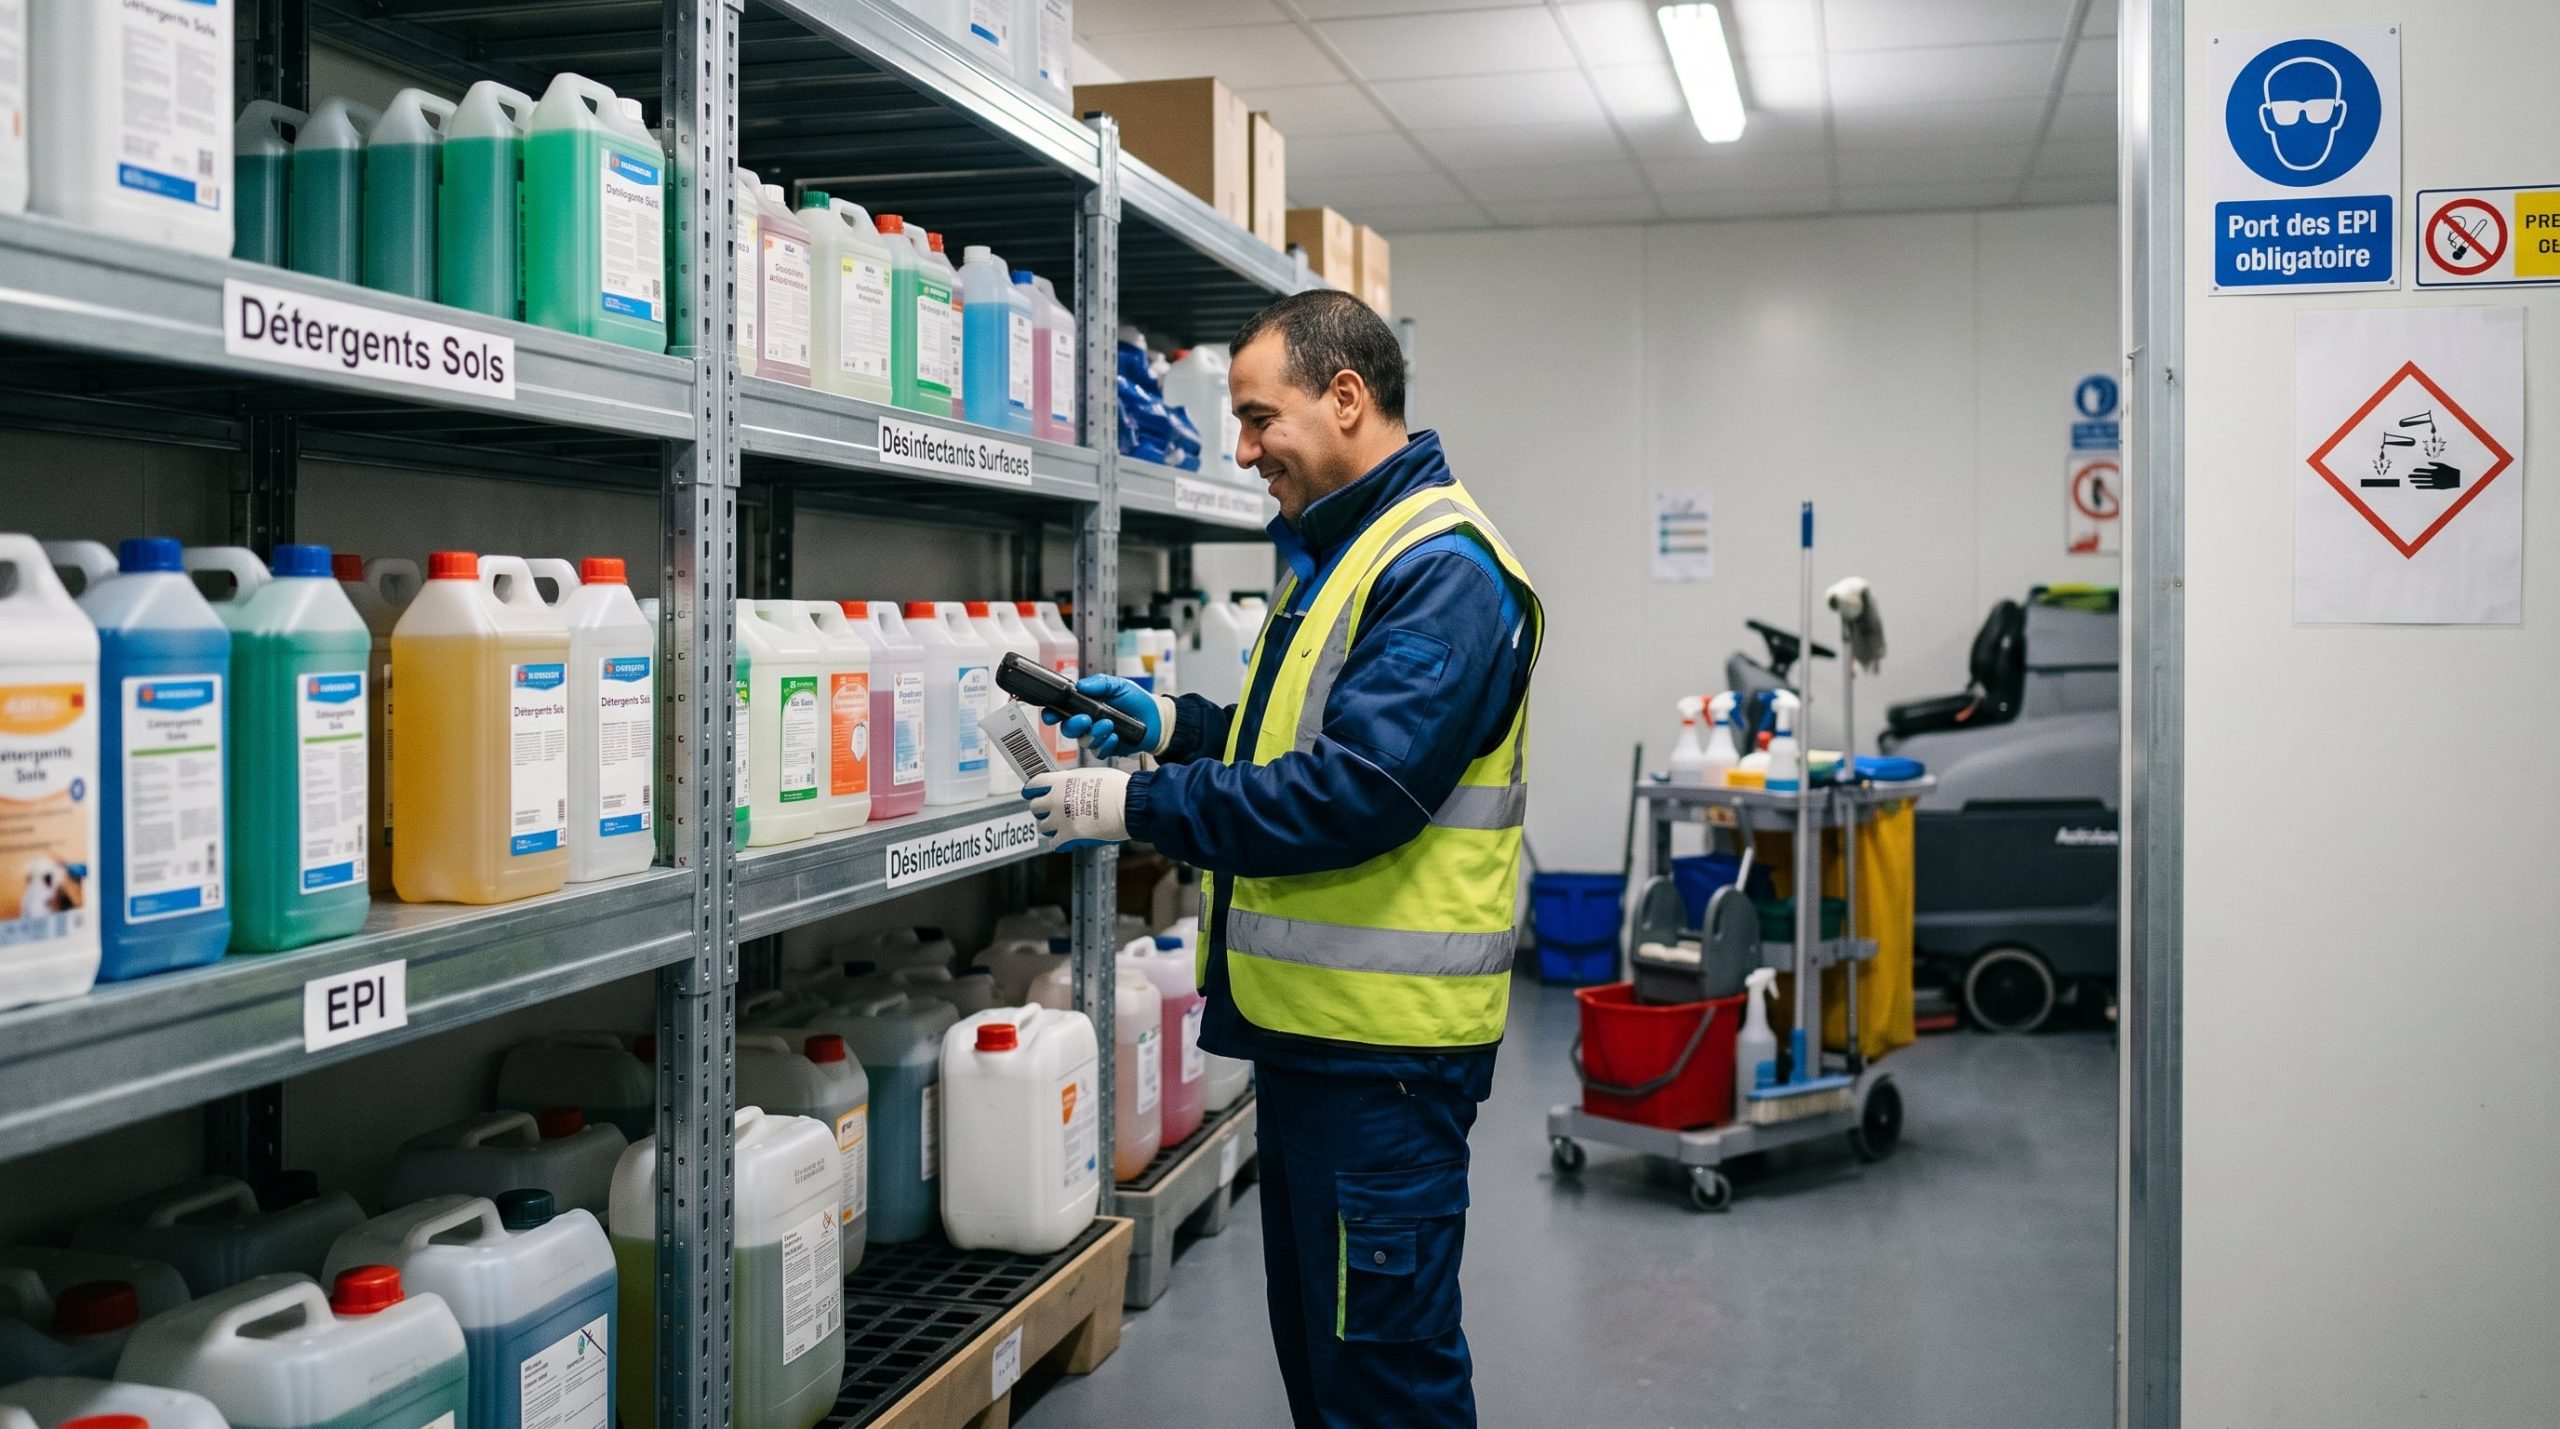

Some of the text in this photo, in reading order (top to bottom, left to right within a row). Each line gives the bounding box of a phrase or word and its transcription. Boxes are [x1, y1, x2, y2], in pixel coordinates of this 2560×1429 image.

[2228, 209, 2377, 239] Port des EPI
[2525, 213, 2560, 229] PRE
[2235, 243, 2371, 276] obligatoire
[240, 294, 505, 383] Détergents Sols
[882, 425, 1030, 477] Désinfectants Surfaces
[891, 822, 1036, 879] Désinfectants Surfaces
[327, 975, 386, 1032] EPI
